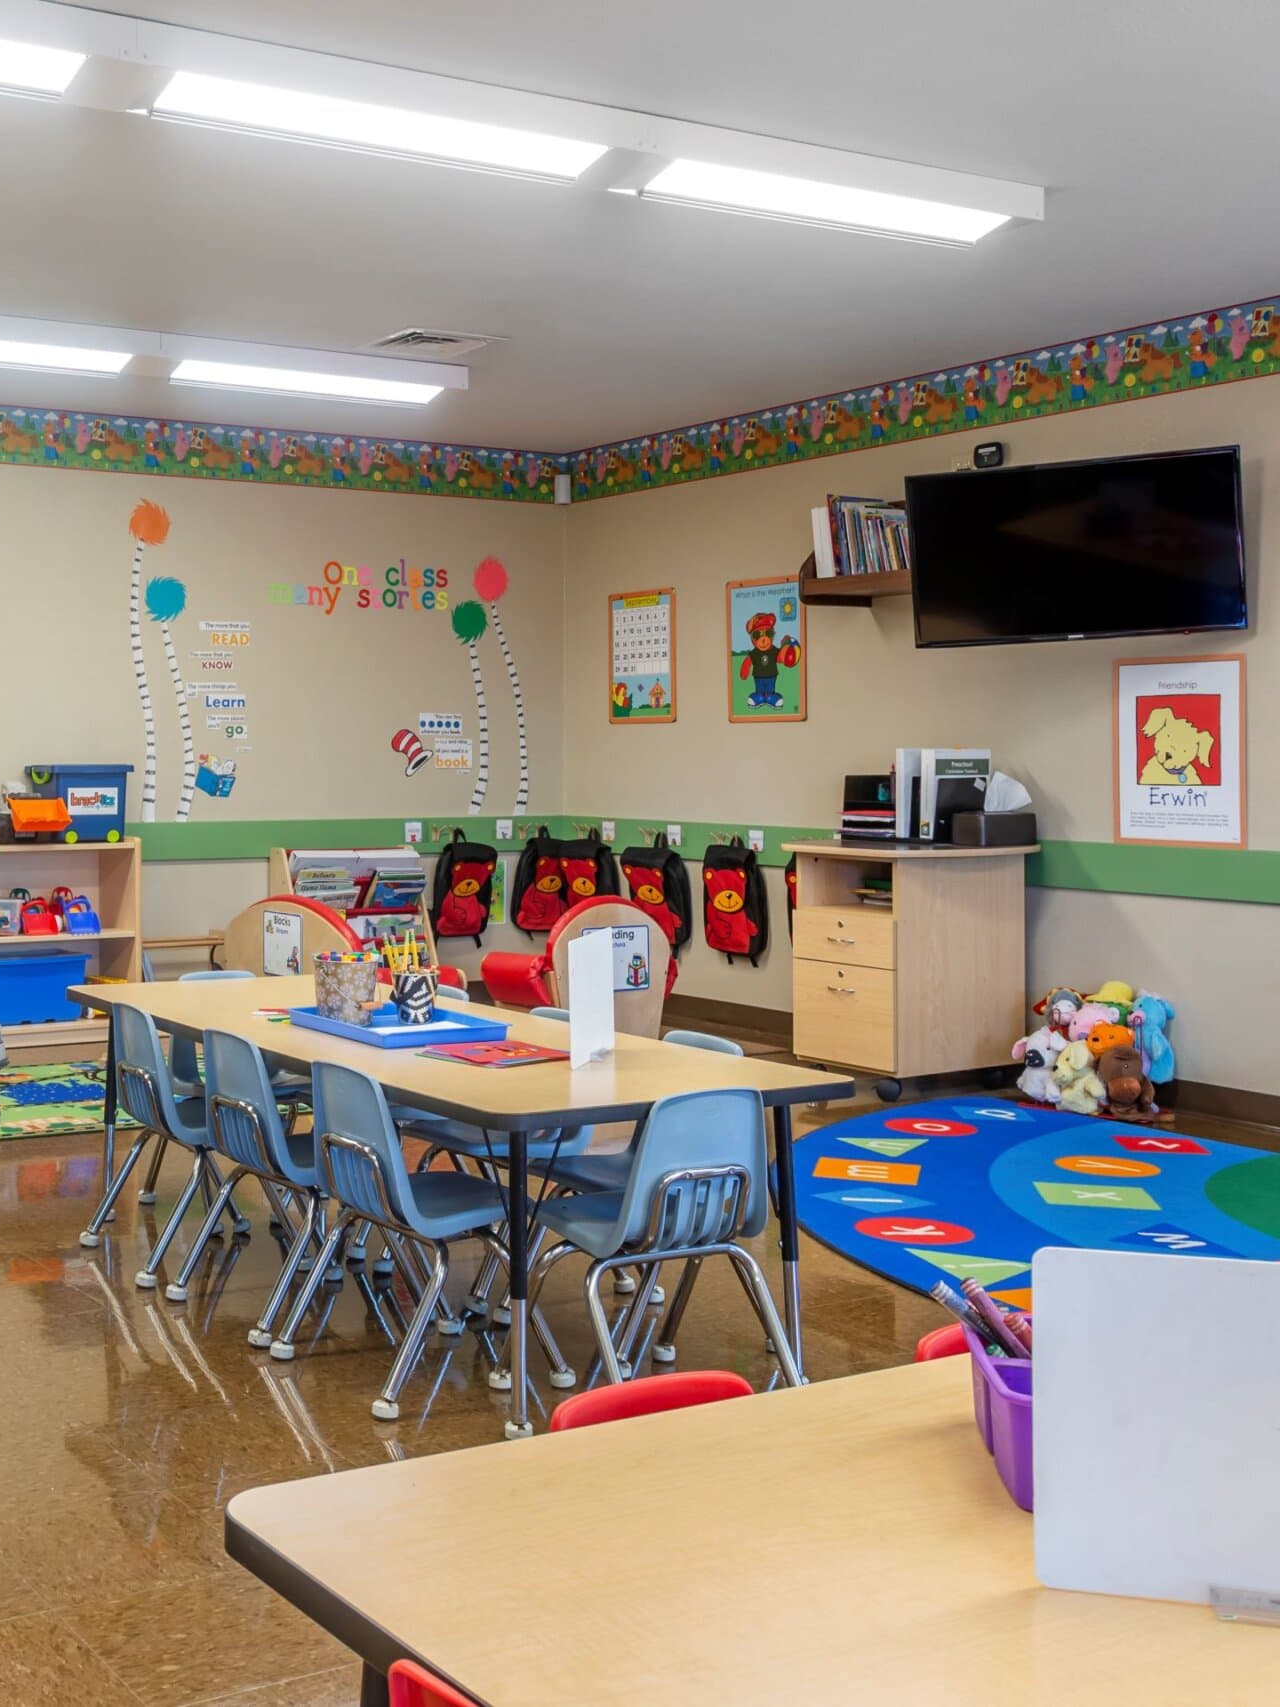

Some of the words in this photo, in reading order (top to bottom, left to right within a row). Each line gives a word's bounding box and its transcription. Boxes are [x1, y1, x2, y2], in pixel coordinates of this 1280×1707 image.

[324, 561, 372, 586] One
[385, 559, 448, 588] class
[269, 583, 341, 615] many
[212, 633, 249, 646] READ
[202, 661, 233, 670] KNOW
[1158, 681, 1197, 691] Friendship
[206, 695, 245, 708] Learn
[435, 755, 469, 768] book
[1149, 787, 1207, 807] Erwin
[274, 915, 291, 927] Blocks
[612, 929, 634, 941] ding
